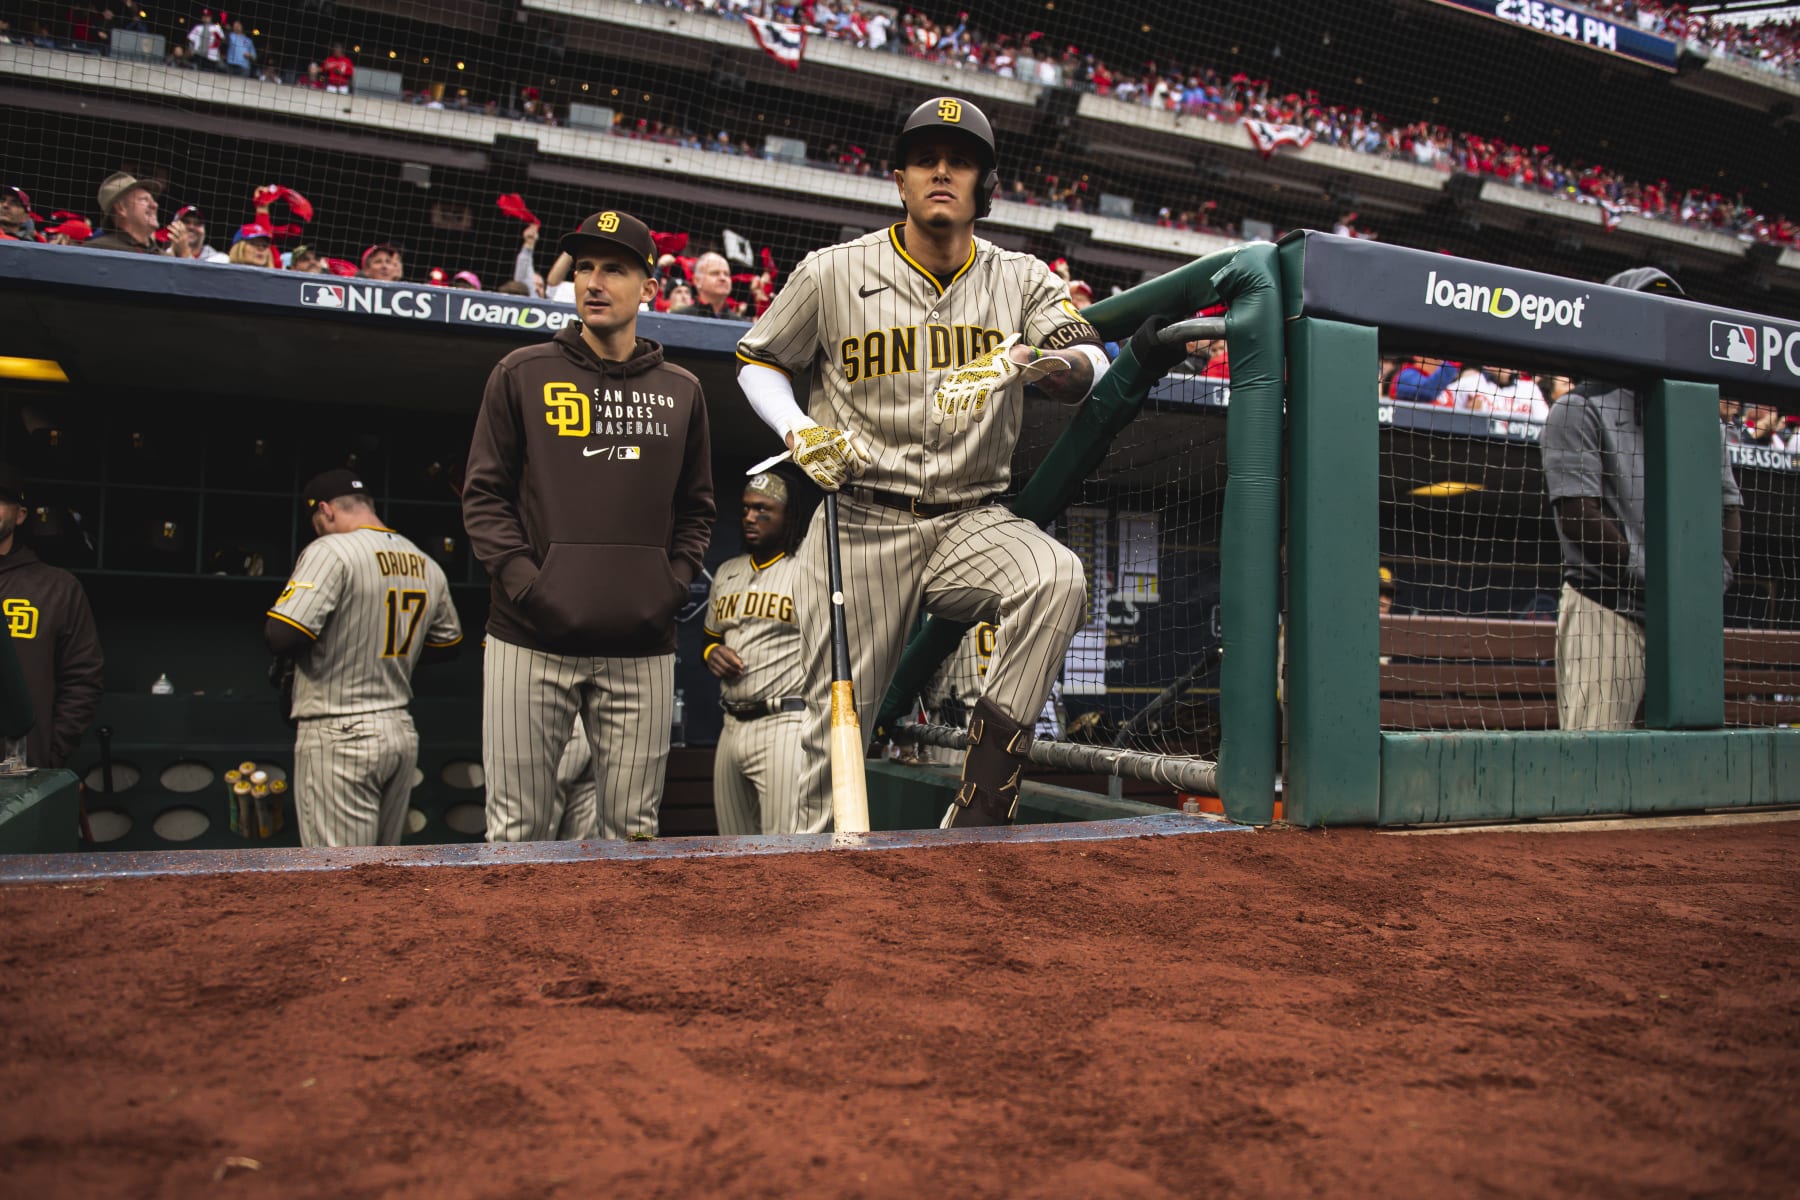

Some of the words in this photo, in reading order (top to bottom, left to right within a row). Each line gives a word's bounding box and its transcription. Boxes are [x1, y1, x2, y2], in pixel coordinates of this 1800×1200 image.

[1583, 18, 1617, 52] PM
[348, 285, 432, 319] NLCS
[1425, 271, 1585, 330] loanDepot
[841, 327, 919, 384] SAN
[593, 388, 623, 402] SAN
[632, 391, 674, 408] DIEGO
[595, 404, 653, 419] PADRES
[594, 420, 669, 437] BASEBALL
[375, 551, 427, 580] DRURY
[381, 587, 428, 659] 17
[714, 592, 741, 622] AN
[743, 591, 794, 624] DIEG
